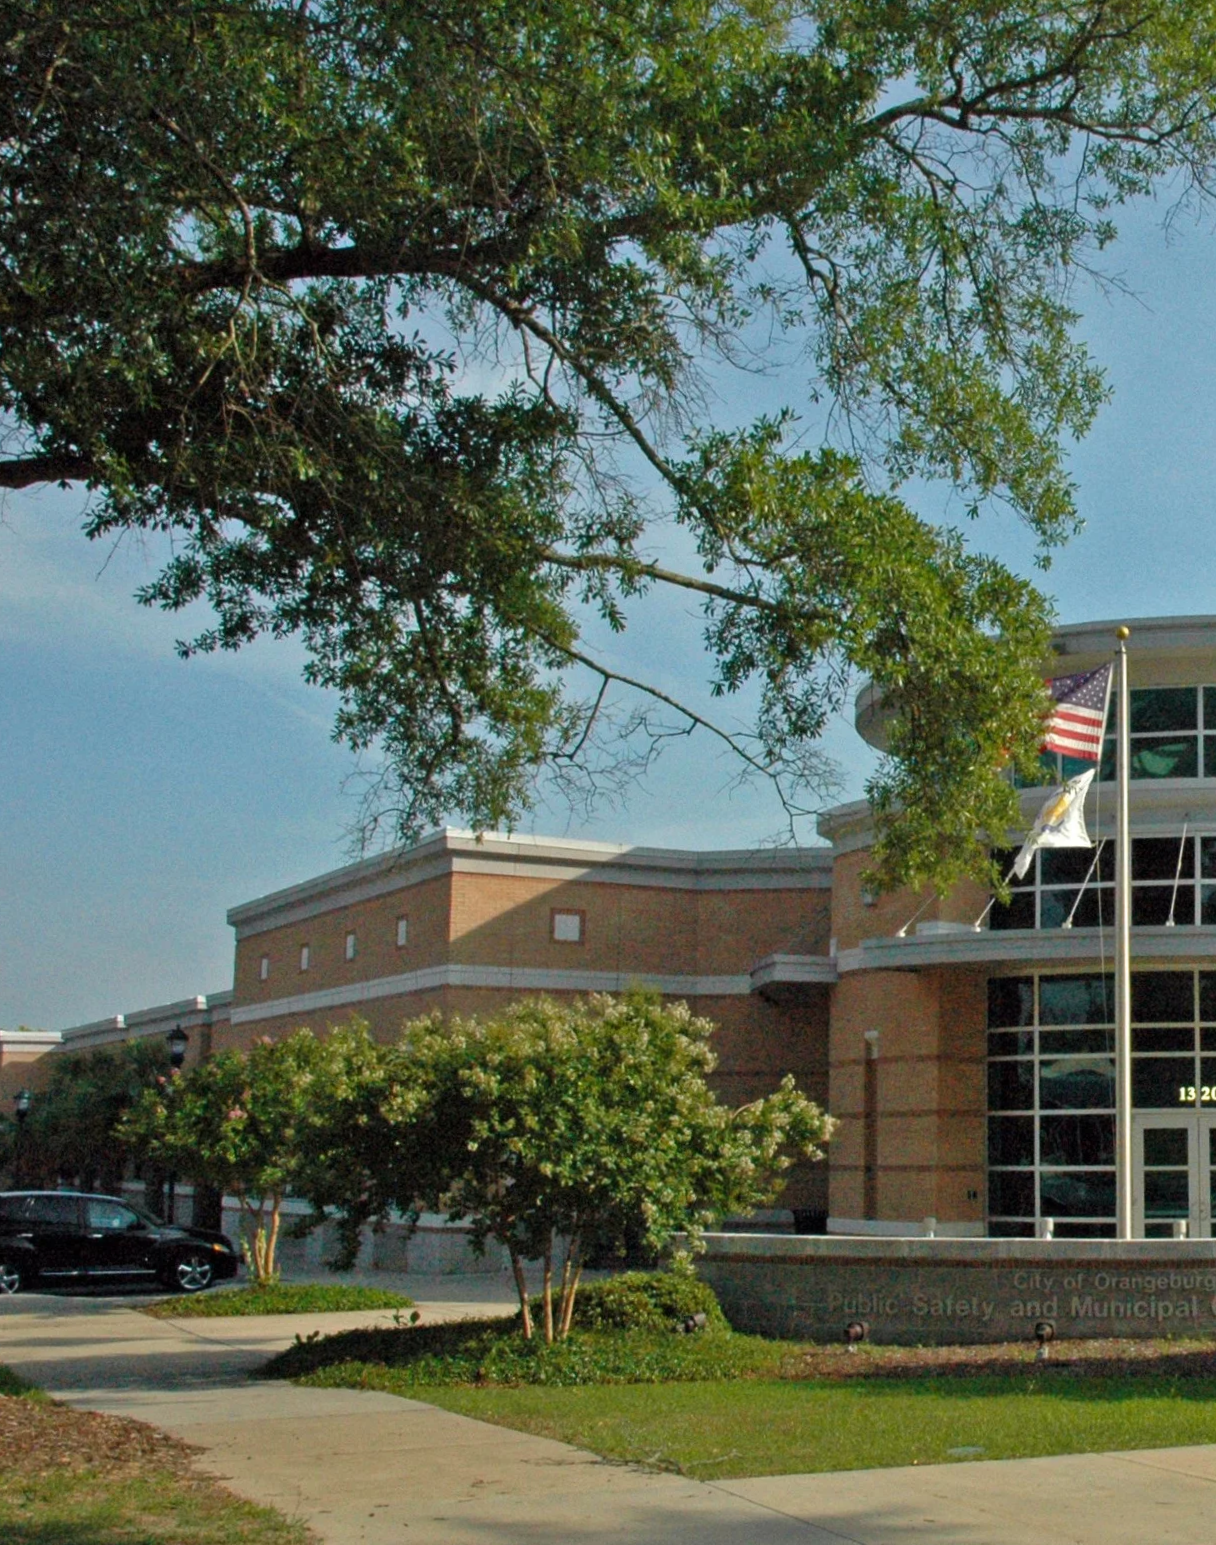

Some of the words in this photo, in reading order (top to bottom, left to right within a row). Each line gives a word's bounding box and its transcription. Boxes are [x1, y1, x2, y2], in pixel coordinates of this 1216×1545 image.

[1013, 1273, 1054, 1291] City
[1063, 1273, 1083, 1290] of
[1094, 1273, 1216, 1292] Orangeburg
[829, 1292, 899, 1314] Public
[912, 1294, 994, 1320] Safety
[1010, 1296, 1058, 1318] and
[1071, 1295, 1198, 1321] Municipal
